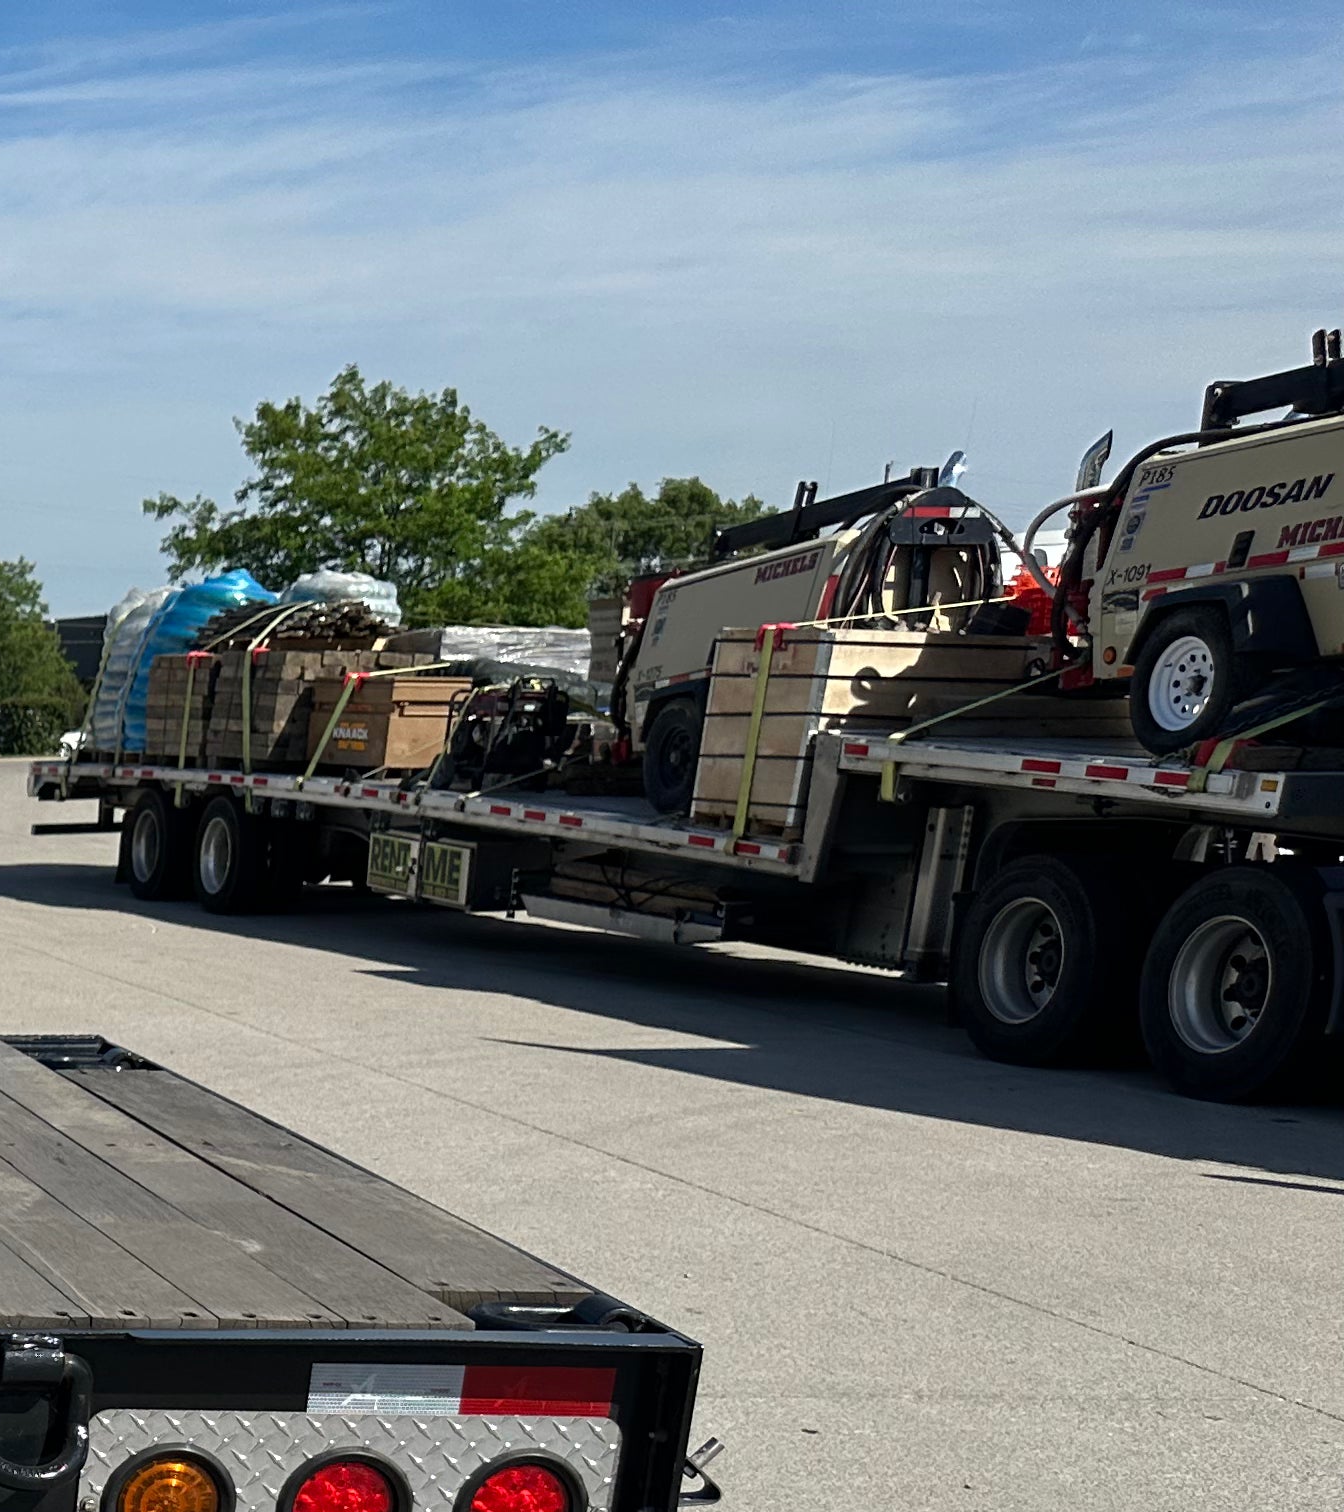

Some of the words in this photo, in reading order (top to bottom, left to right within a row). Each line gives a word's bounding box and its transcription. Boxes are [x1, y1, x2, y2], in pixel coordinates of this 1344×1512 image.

[1138, 465, 1176, 486] P185
[1197, 472, 1336, 521] DOOSAN
[1276, 516, 1344, 549] MICH
[754, 552, 820, 585] MICHELS
[424, 846, 462, 889] ME
